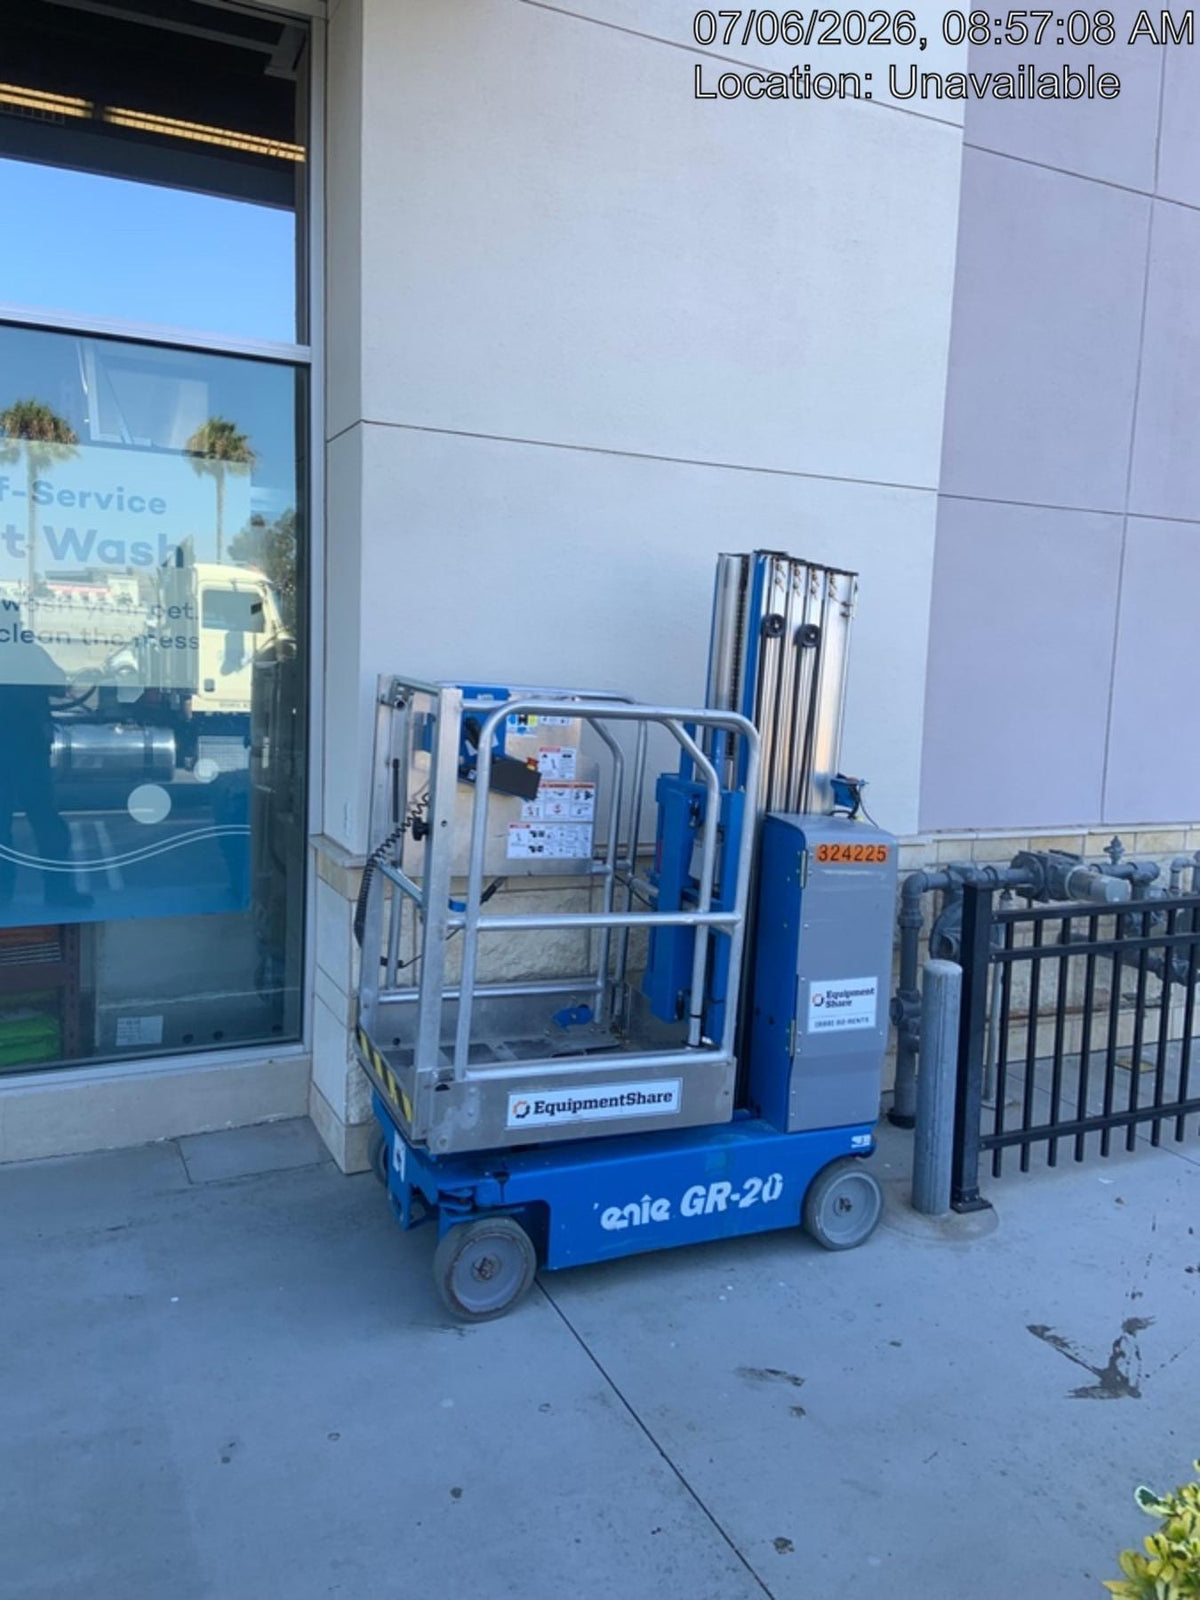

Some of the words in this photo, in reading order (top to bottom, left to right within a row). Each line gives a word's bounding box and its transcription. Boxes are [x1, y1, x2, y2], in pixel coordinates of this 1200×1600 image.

[43, 525, 184, 568] Wash
[80, 627, 124, 647] the
[818, 844, 887, 862] 324225
[826, 987, 875, 999] Equipment
[826, 1000, 852, 1008] Share
[533, 1092, 673, 1116] EquipmentShare
[594, 1194, 671, 1231] enie
[680, 1173, 784, 1217] GR-20
